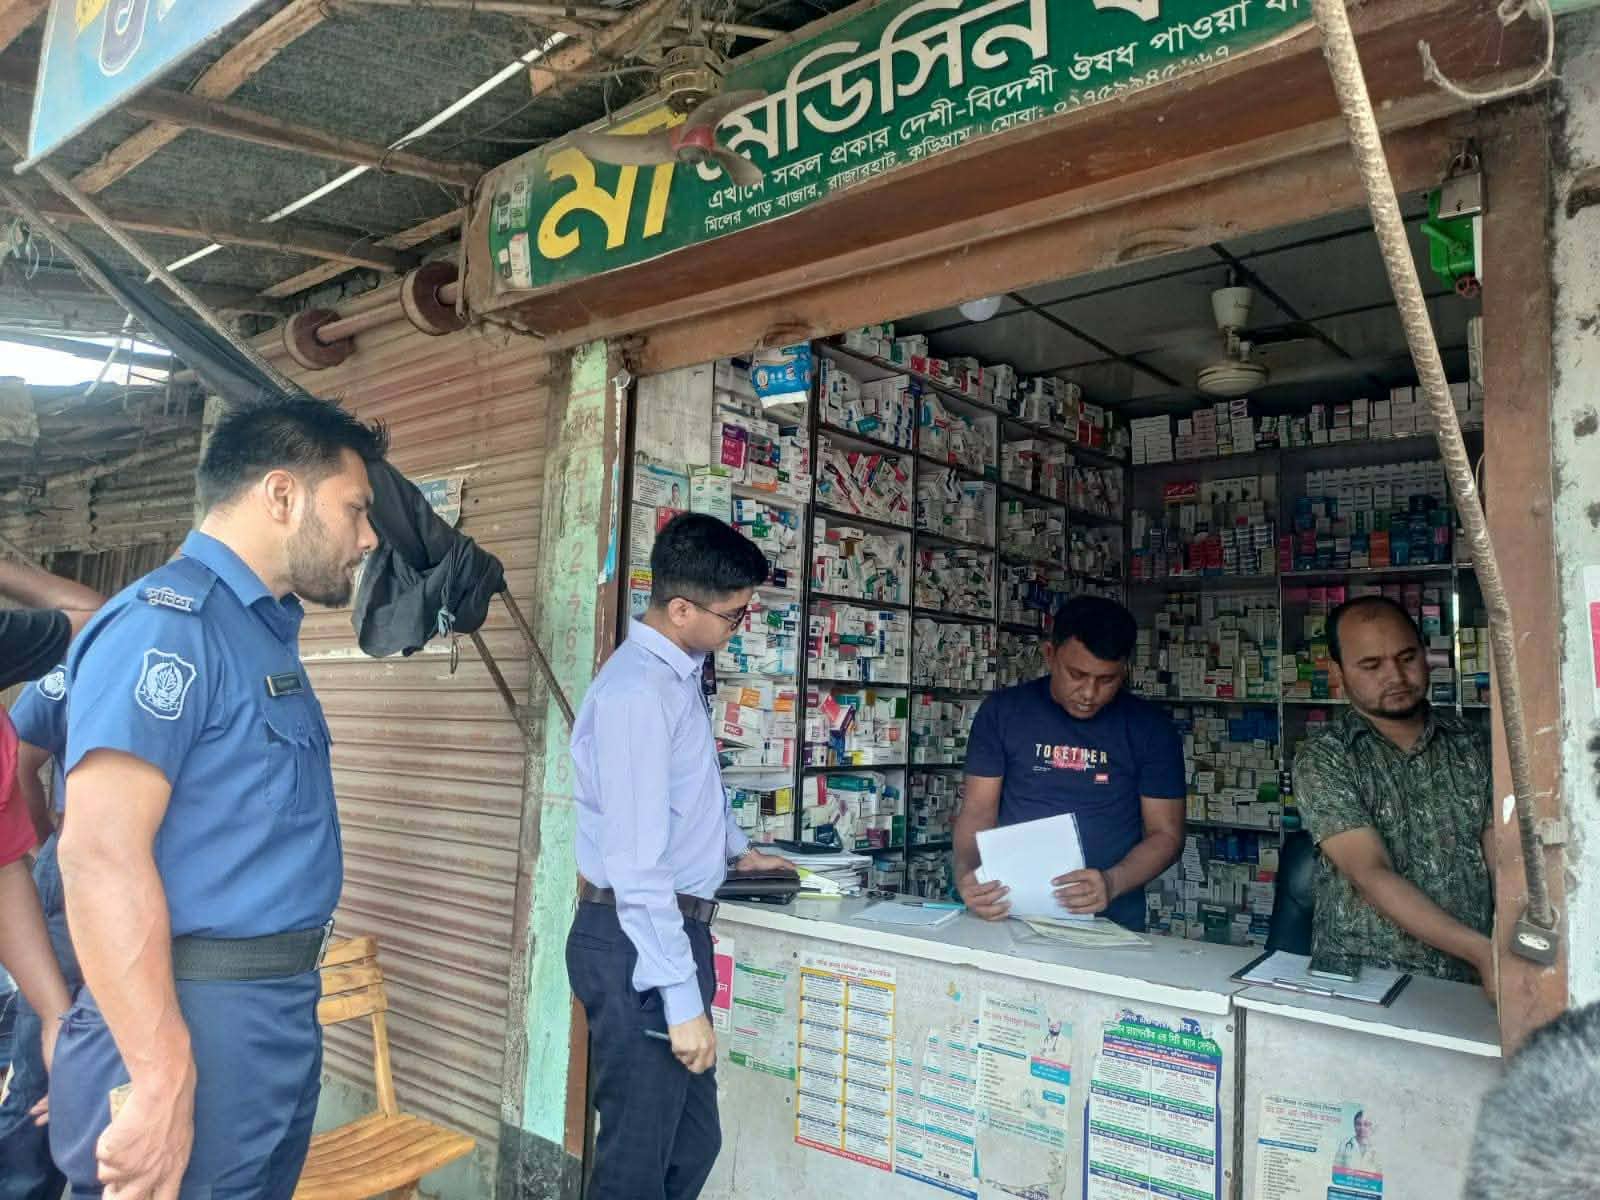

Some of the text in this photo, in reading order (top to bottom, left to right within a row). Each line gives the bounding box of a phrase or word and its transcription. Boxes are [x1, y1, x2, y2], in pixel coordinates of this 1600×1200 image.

[708, 173, 766, 209] এখানে
[771, 152, 824, 186] সকল
[829, 126, 889, 165] প্রকার
[900, 64, 1058, 140] দেশী-বিদেশী
[1068, 41, 1139, 81] ঔষধ
[1150, 0, 1251, 53] পাওয়া
[538, 105, 689, 260] মা
[704, 209, 742, 233] মিলের
[747, 199, 774, 218] পাড়
[1035, 743, 1108, 764] TOGETHER
